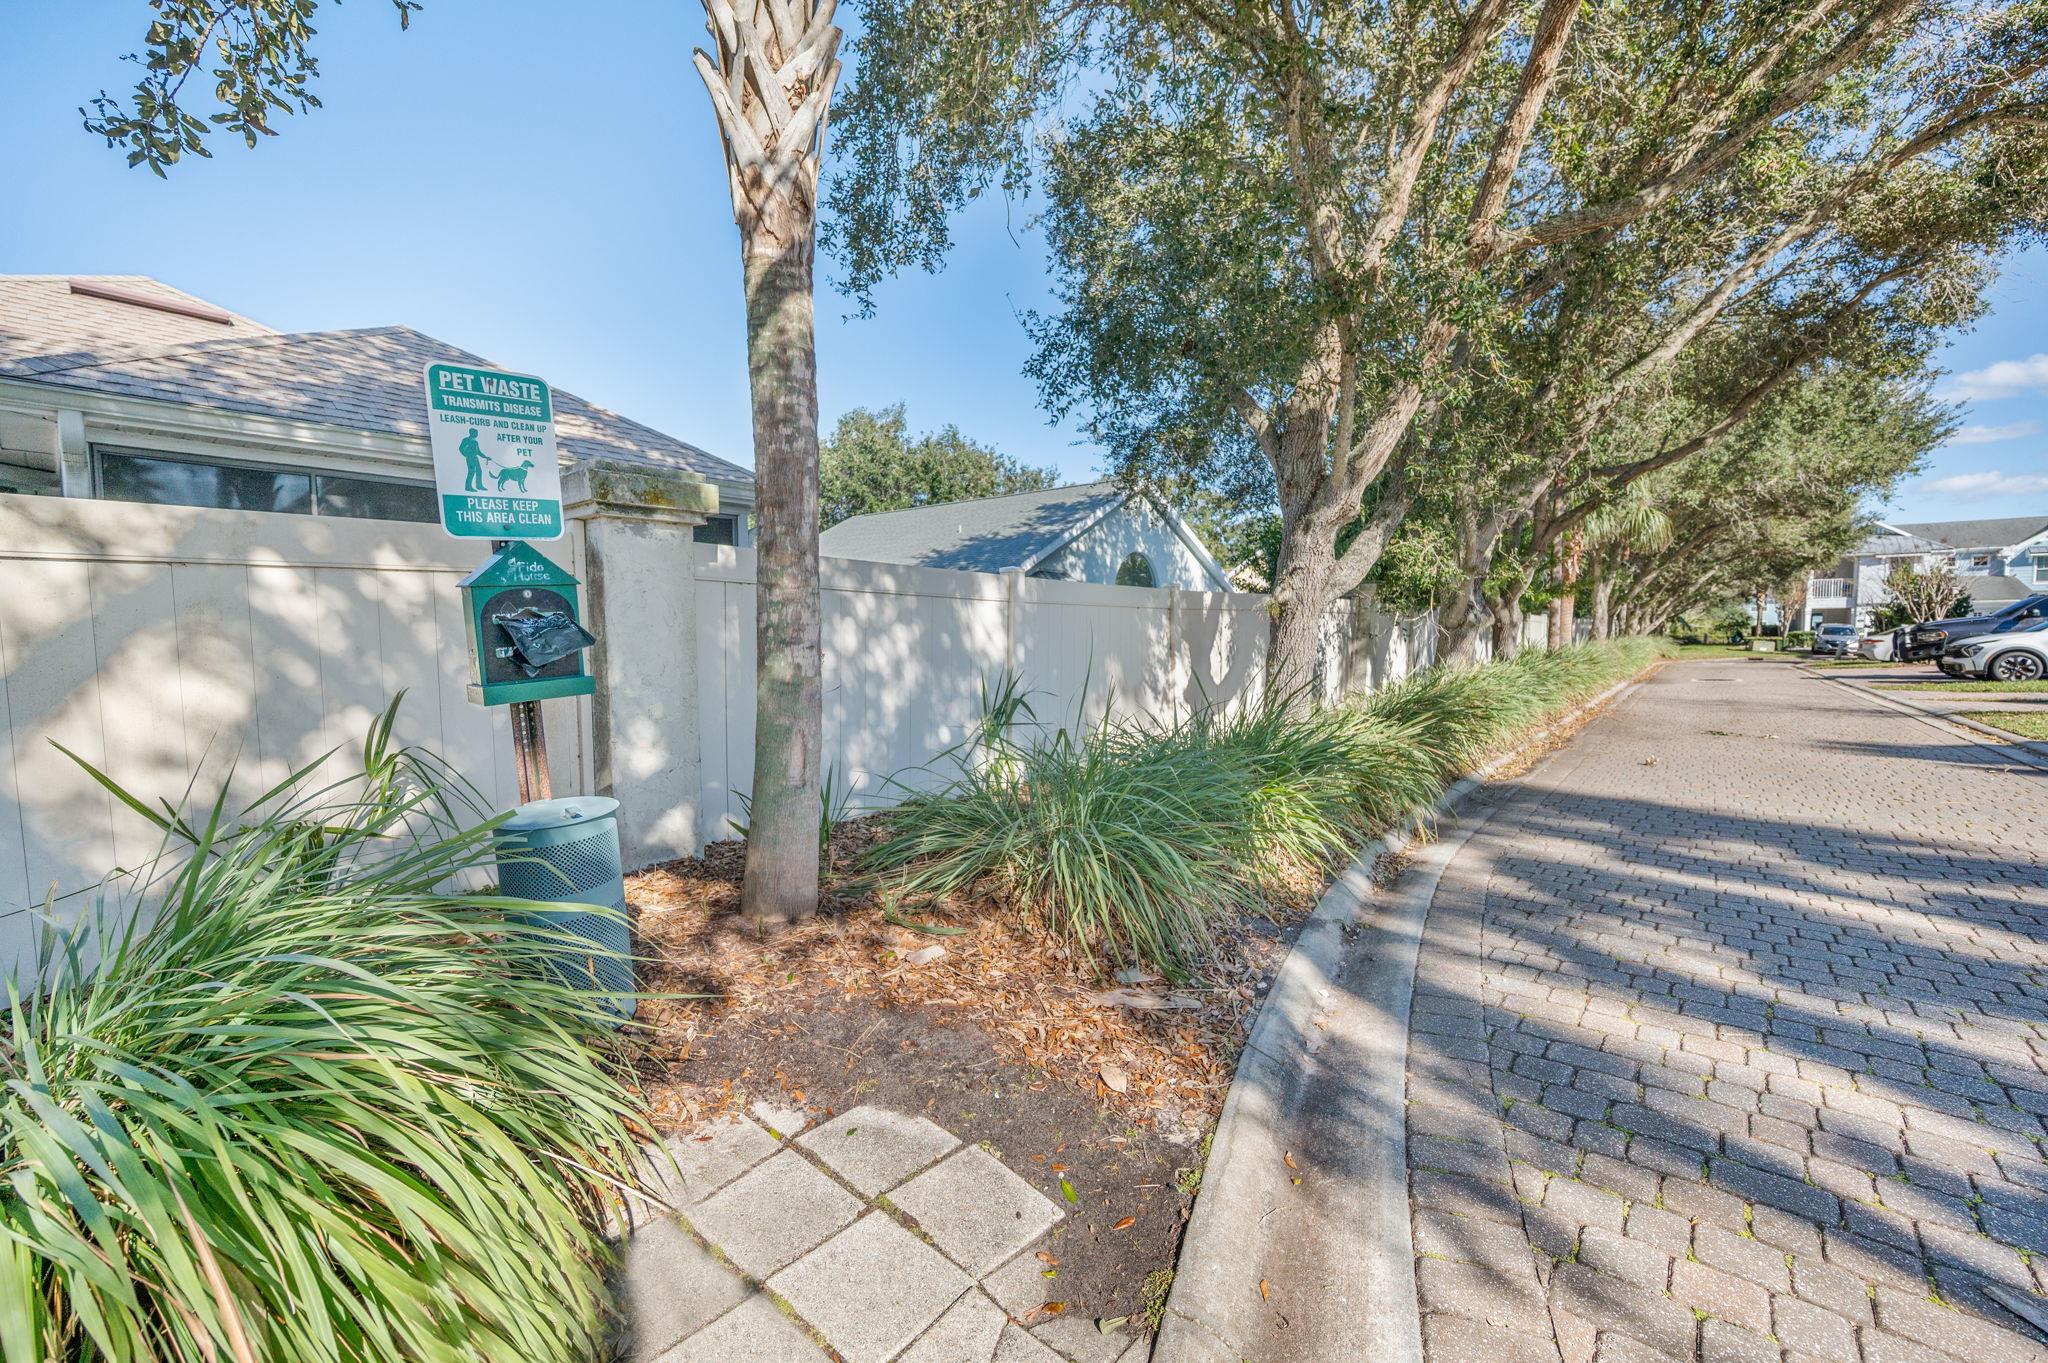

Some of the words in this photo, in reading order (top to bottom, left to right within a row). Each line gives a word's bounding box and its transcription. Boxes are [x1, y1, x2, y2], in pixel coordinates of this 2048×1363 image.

[439, 371, 474, 390] PET
[480, 377, 540, 399] WASTE
[441, 395, 500, 411] TRANSMITS
[503, 403, 542, 416] DISEASE
[440, 414, 490, 426] LEASH-CURB
[493, 420, 508, 428] AND
[511, 422, 534, 431] CLEAN
[537, 425, 546, 433] UP
[497, 434, 520, 443] AFTER
[523, 436, 543, 445] YOUR
[516, 448, 532, 457] PET
[467, 498, 509, 510] PLEASE
[513, 500, 538, 511] KEEP
[456, 511, 483, 523] THIS
[487, 512, 514, 523] AREA
[518, 513, 551, 524] CLEAN
